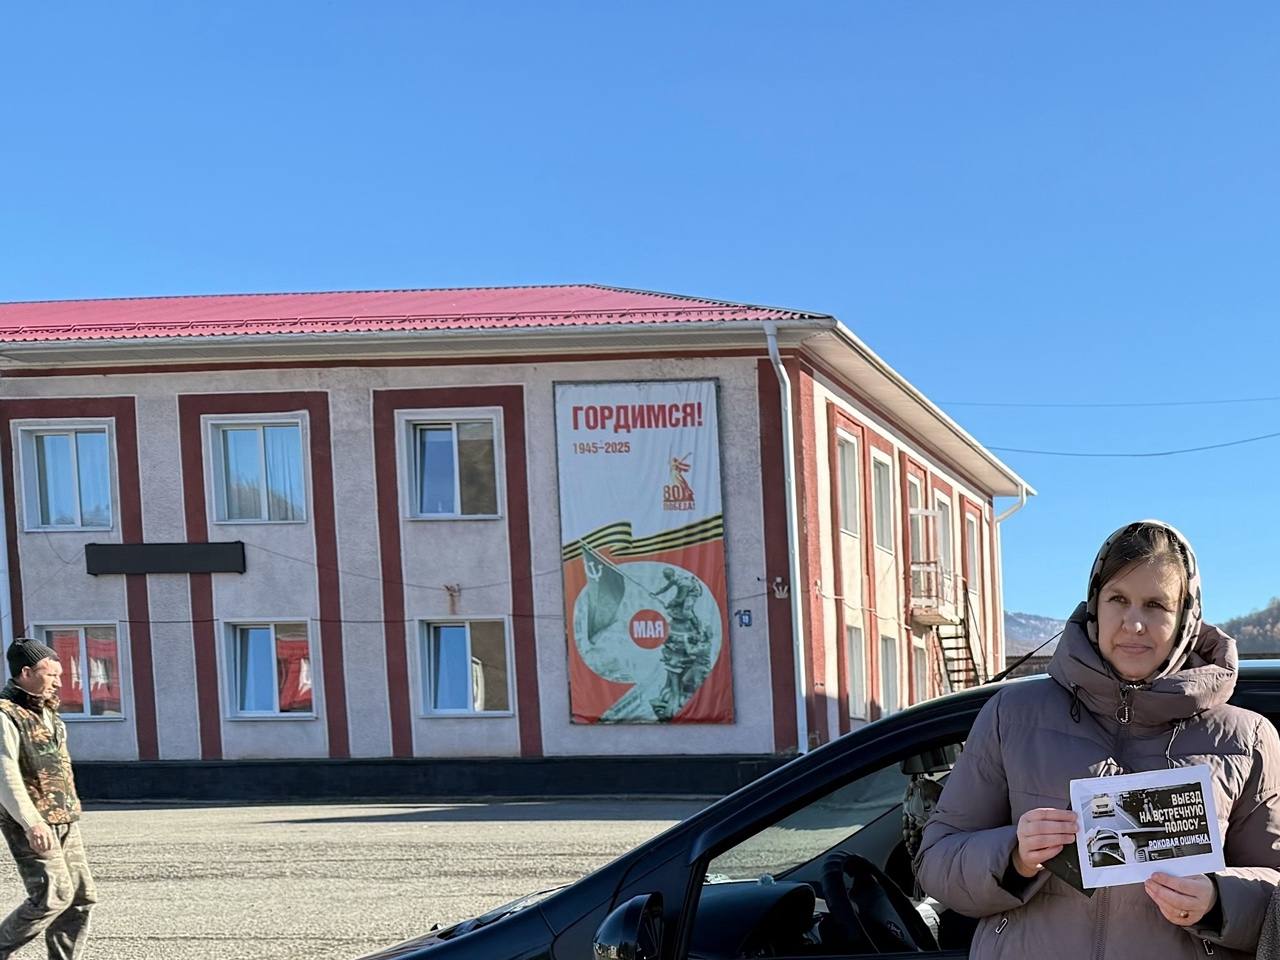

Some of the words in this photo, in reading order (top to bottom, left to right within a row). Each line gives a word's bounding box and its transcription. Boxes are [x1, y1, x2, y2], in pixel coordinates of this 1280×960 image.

[572, 401, 703, 433] ГОРДИМСЯ!
[663, 485, 680, 500] 80
[633, 620, 665, 638] МАЯ
[1171, 791, 1202, 805] ВЫЕЗД
[1139, 811, 1152, 823] НА
[1153, 804, 1204, 821] ВСТРЕЧНУЮ
[1165, 818, 1198, 833] ПОЛОСУ
[1148, 837, 1179, 849] РОКОВАЯ
[1180, 833, 1209, 845] ОШИБКА
